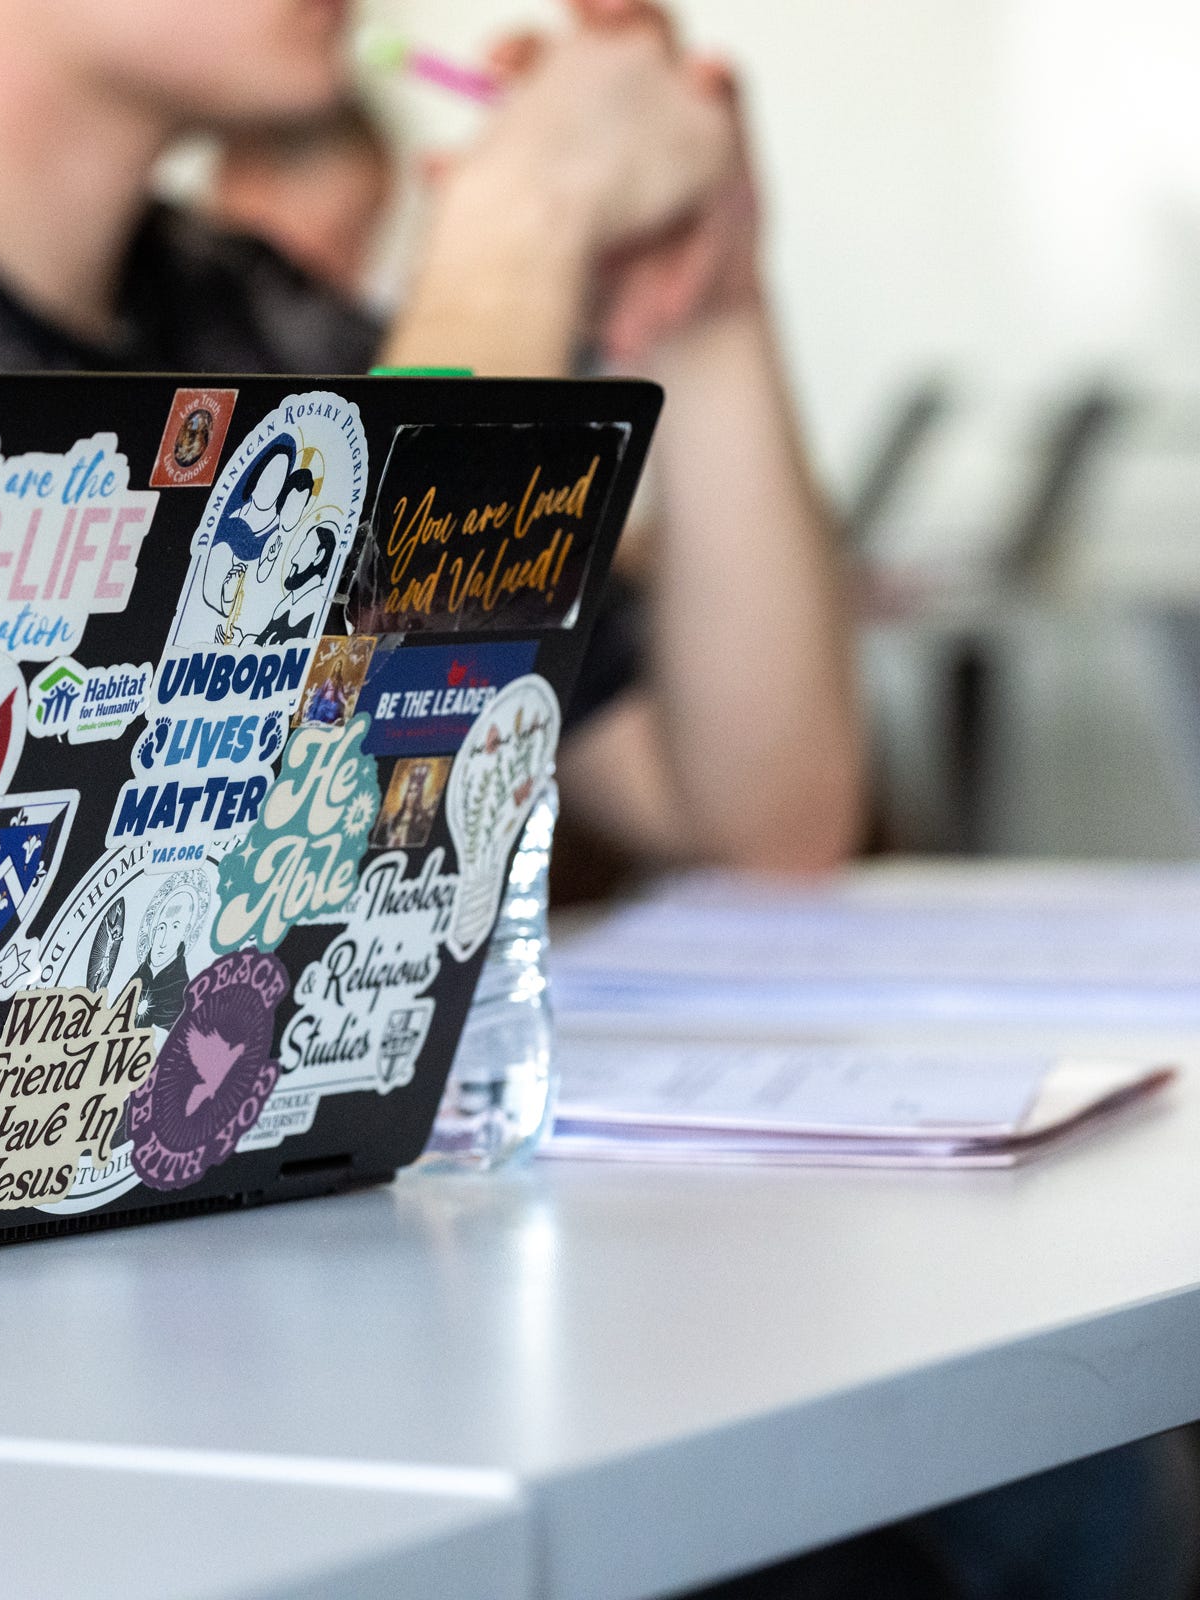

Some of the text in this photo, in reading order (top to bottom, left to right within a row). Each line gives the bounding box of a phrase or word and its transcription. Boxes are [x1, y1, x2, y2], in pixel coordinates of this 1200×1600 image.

[179, 398, 199, 419] Live
[5, 467, 56, 499] are
[61, 450, 117, 504] the
[163, 452, 175, 478] Live
[198, 402, 361, 549] DOMINICAN ROSARY PILGRIMAGE
[387, 486, 457, 584] You
[461, 501, 513, 535] are
[384, 550, 448, 614] and
[83, 673, 146, 702] Habitat
[157, 647, 311, 704] UNBORN
[374, 692, 402, 719] BE
[401, 690, 435, 718] THE
[79, 699, 140, 719] for Humanity
[164, 715, 260, 768] LIVES
[112, 775, 268, 837] MATTER
[264, 720, 366, 836] He
[151, 844, 204, 863] YAF.ORG
[216, 833, 353, 946] Able
[365, 859, 456, 934] Theology
[189, 954, 286, 1012] PEACE
[302, 937, 432, 1014] & Religious
[5, 985, 138, 1047] What A
[281, 1012, 370, 1075] Studies
[99, 1035, 151, 1087] We
[76, 1093, 119, 1162] In
[136, 1131, 206, 1181] WITH
